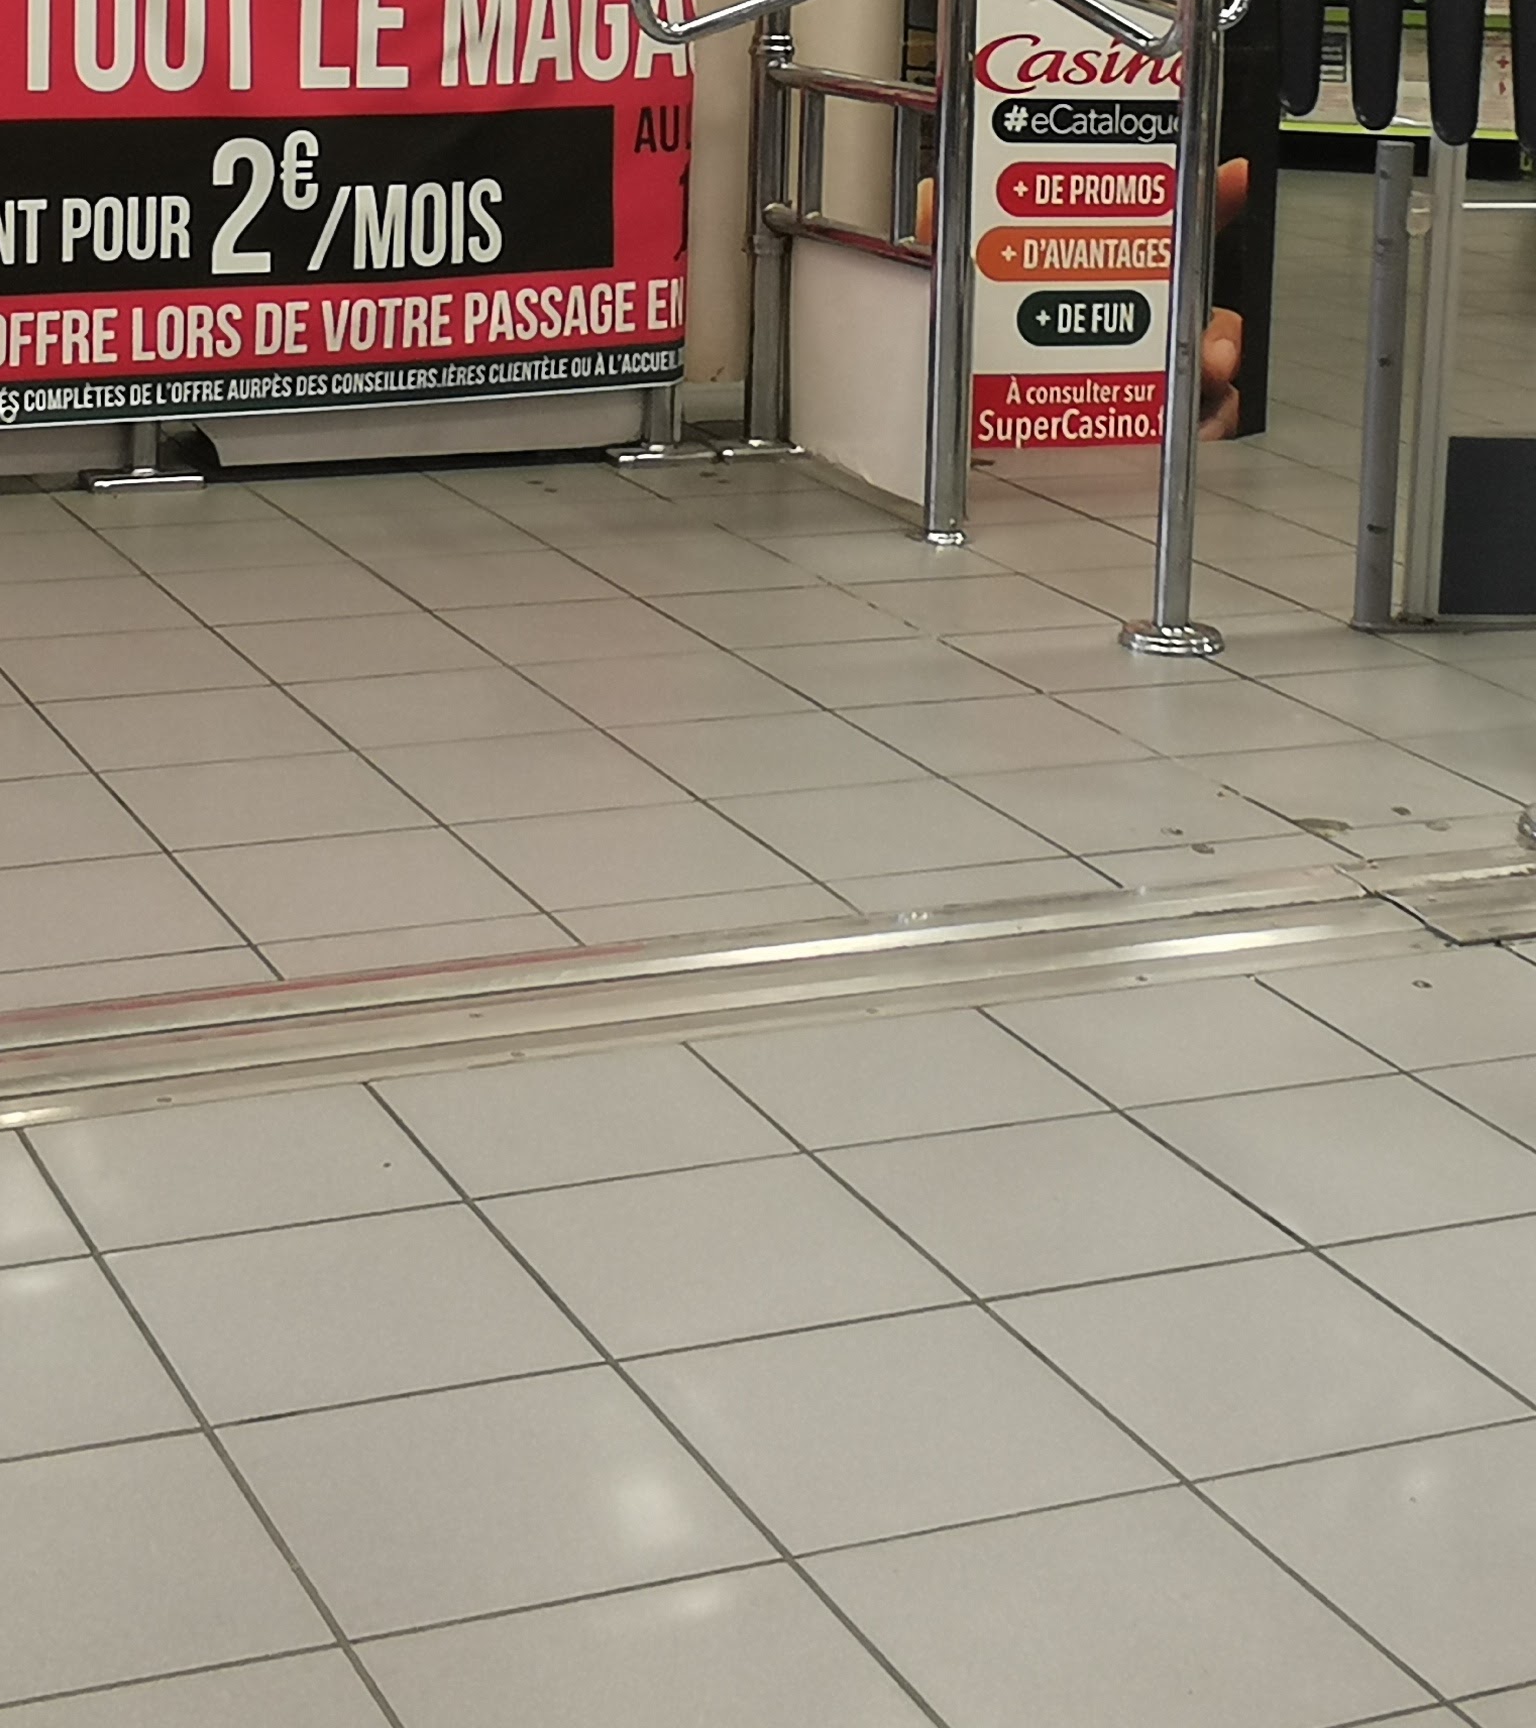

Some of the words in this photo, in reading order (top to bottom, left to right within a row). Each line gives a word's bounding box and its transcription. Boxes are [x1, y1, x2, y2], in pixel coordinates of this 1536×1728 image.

[634, 104, 692, 153] AU
[1003, 103, 1179, 143] #eCatalogu
[1035, 174, 1065, 206] DE
[1069, 174, 1166, 206] PROMOS
[61, 192, 192, 265] POUR
[1023, 237, 1172, 270] D'AVANTAGES
[130, 299, 244, 364] LORS
[257, 298, 310, 358] DE
[321, 290, 454, 355] VOTRE
[463, 282, 640, 346] PASSAGE
[648, 277, 685, 332] EN
[1057, 302, 1086, 333] DE
[1091, 302, 1135, 333] FUN
[23, 382, 126, 413] COMPLÈTES
[129, 382, 153, 406] DE
[156, 379, 224, 406] L'OFFRE
[227, 373, 292, 401] AURPÈS
[296, 373, 328, 396] DES
[489, 354, 569, 384] CLIENTÈLE
[571, 355, 592, 378] OU
[594, 351, 606, 377] À
[1005, 375, 1021, 405] À
[1025, 378, 1120, 405] consulter
[1123, 383, 1156, 403] sur
[977, 404, 1164, 450] SuperCasino.f
